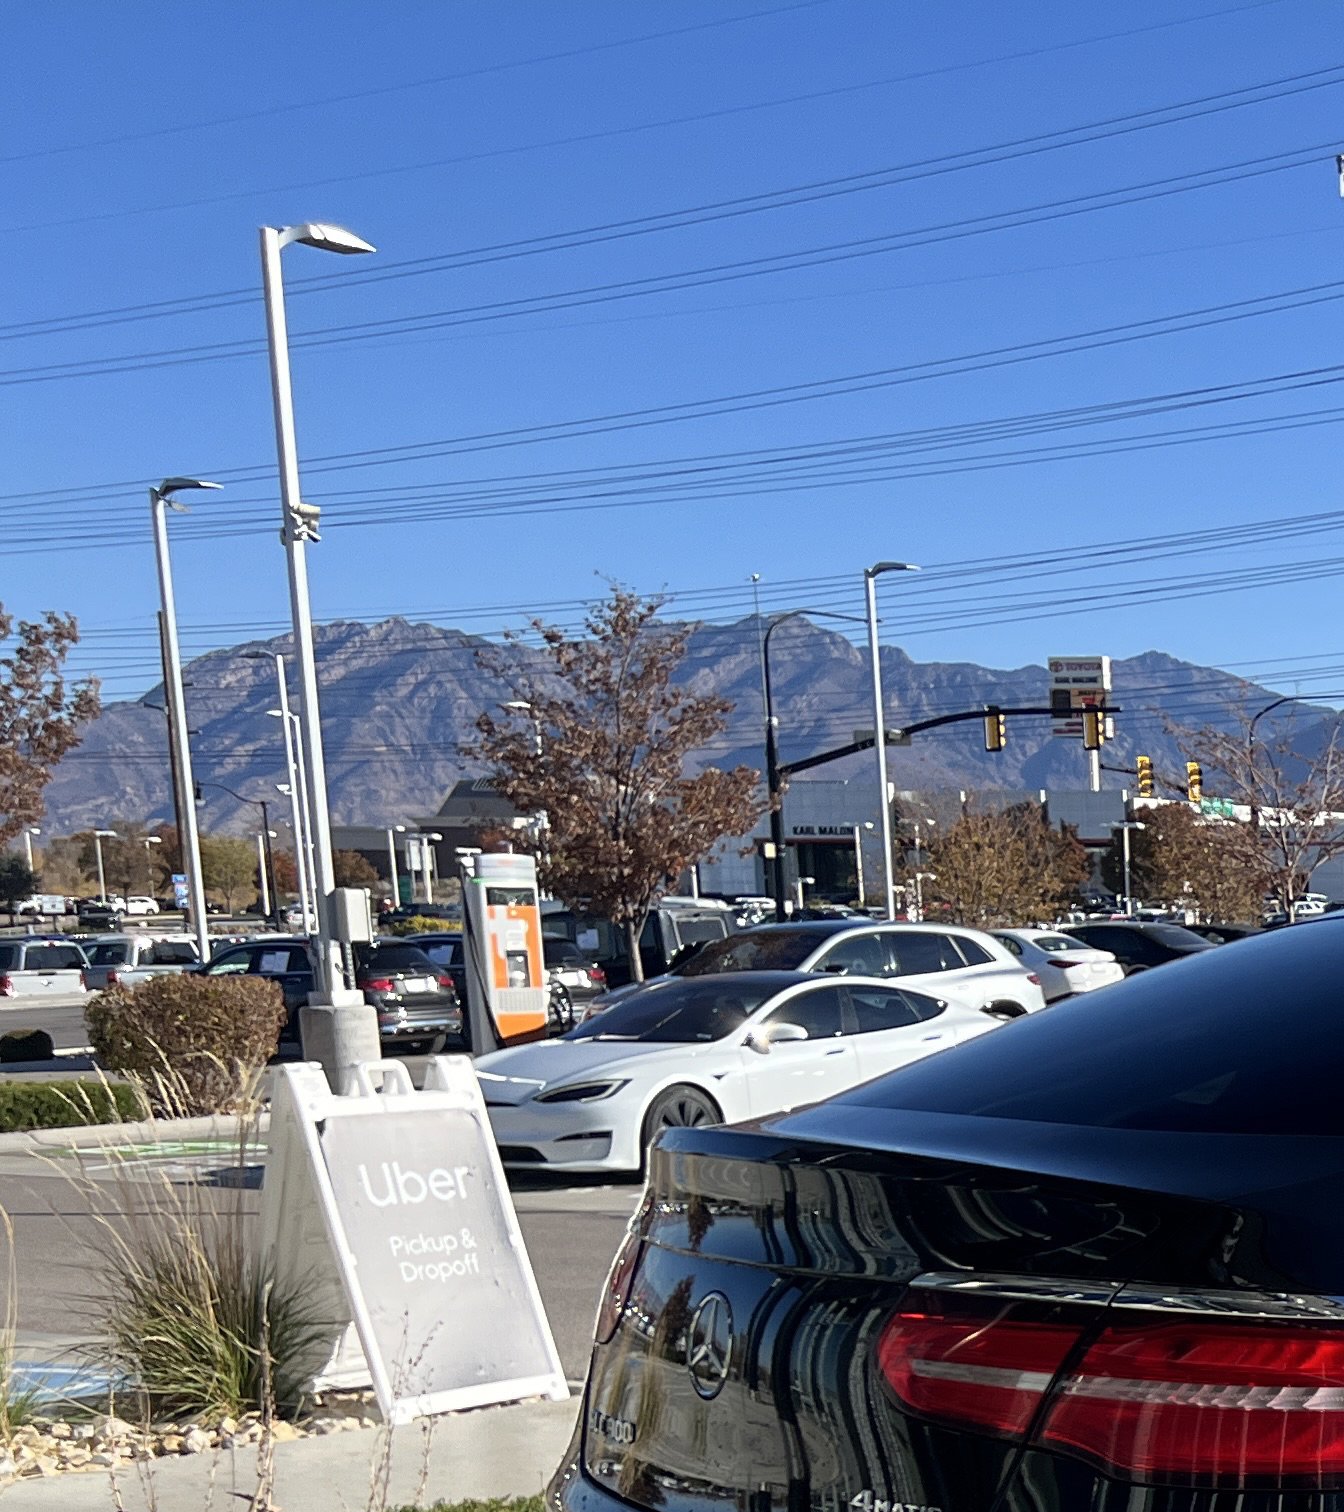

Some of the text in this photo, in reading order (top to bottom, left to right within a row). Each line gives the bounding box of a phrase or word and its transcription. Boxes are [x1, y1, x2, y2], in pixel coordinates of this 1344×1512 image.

[358, 1161, 470, 1208] Uber
[389, 1227, 478, 1257] Pickup &
[399, 1252, 480, 1282] Dropoff
